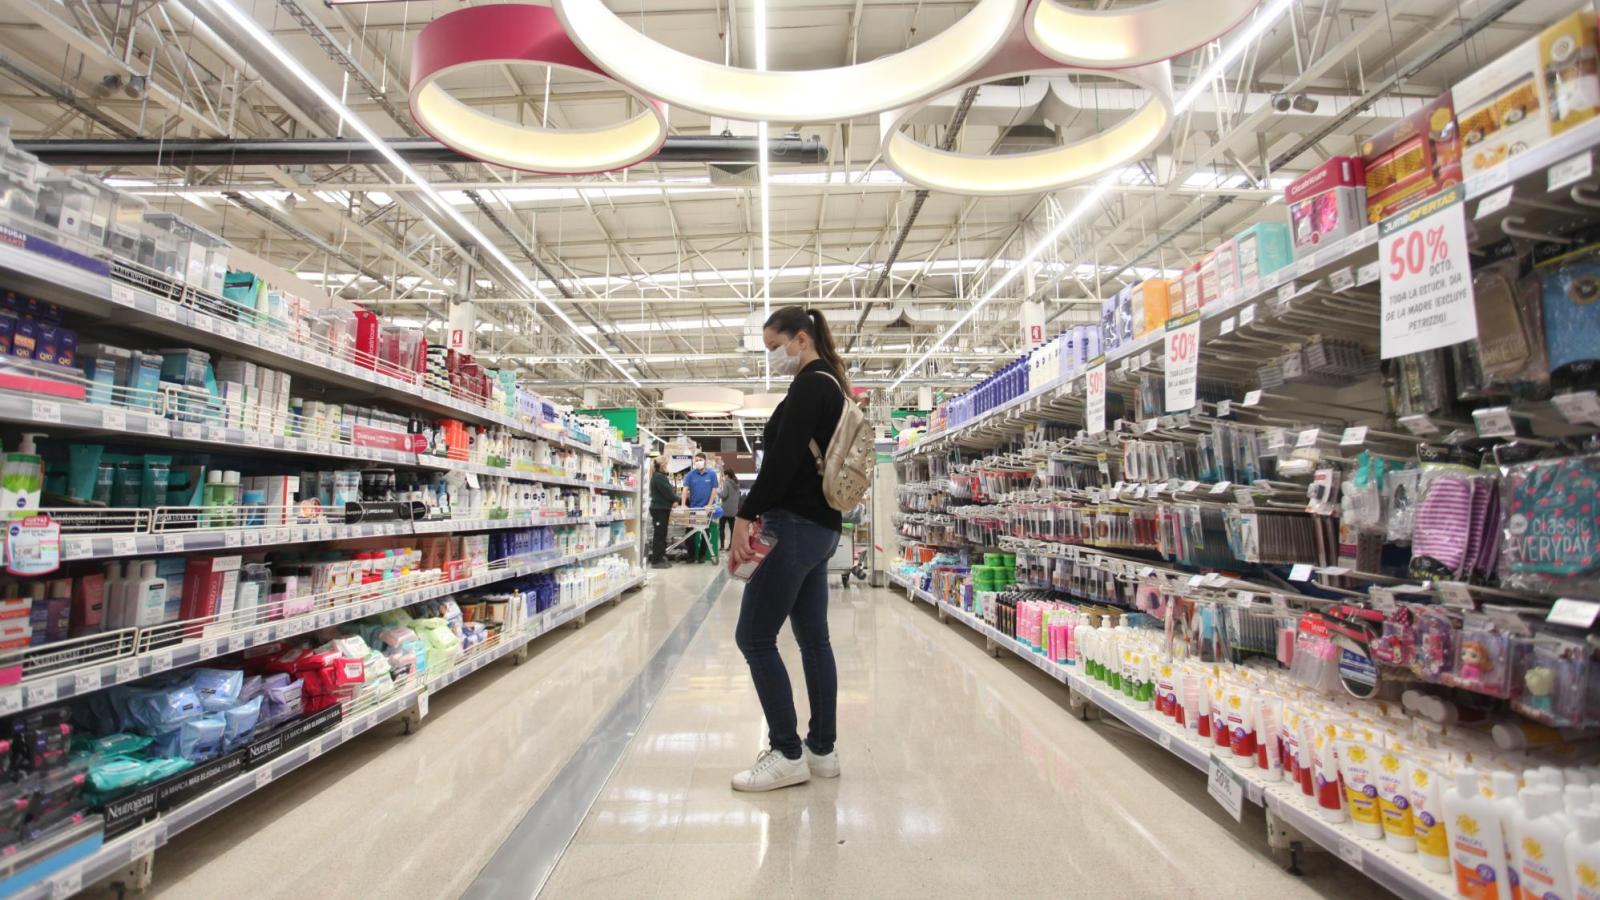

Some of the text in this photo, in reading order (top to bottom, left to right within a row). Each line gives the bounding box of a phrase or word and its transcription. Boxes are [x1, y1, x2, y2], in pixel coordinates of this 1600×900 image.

[1390, 225, 1448, 281] 50%
[1408, 288, 1418, 300] LA
[1386, 311, 1396, 321] DE
[1396, 307, 1407, 319] LA
[1407, 299, 1433, 315] MADRE
[1532, 513, 1590, 536] classic
[107, 793, 154, 820] Neutrogena
[169, 777, 189, 793] MARCA
